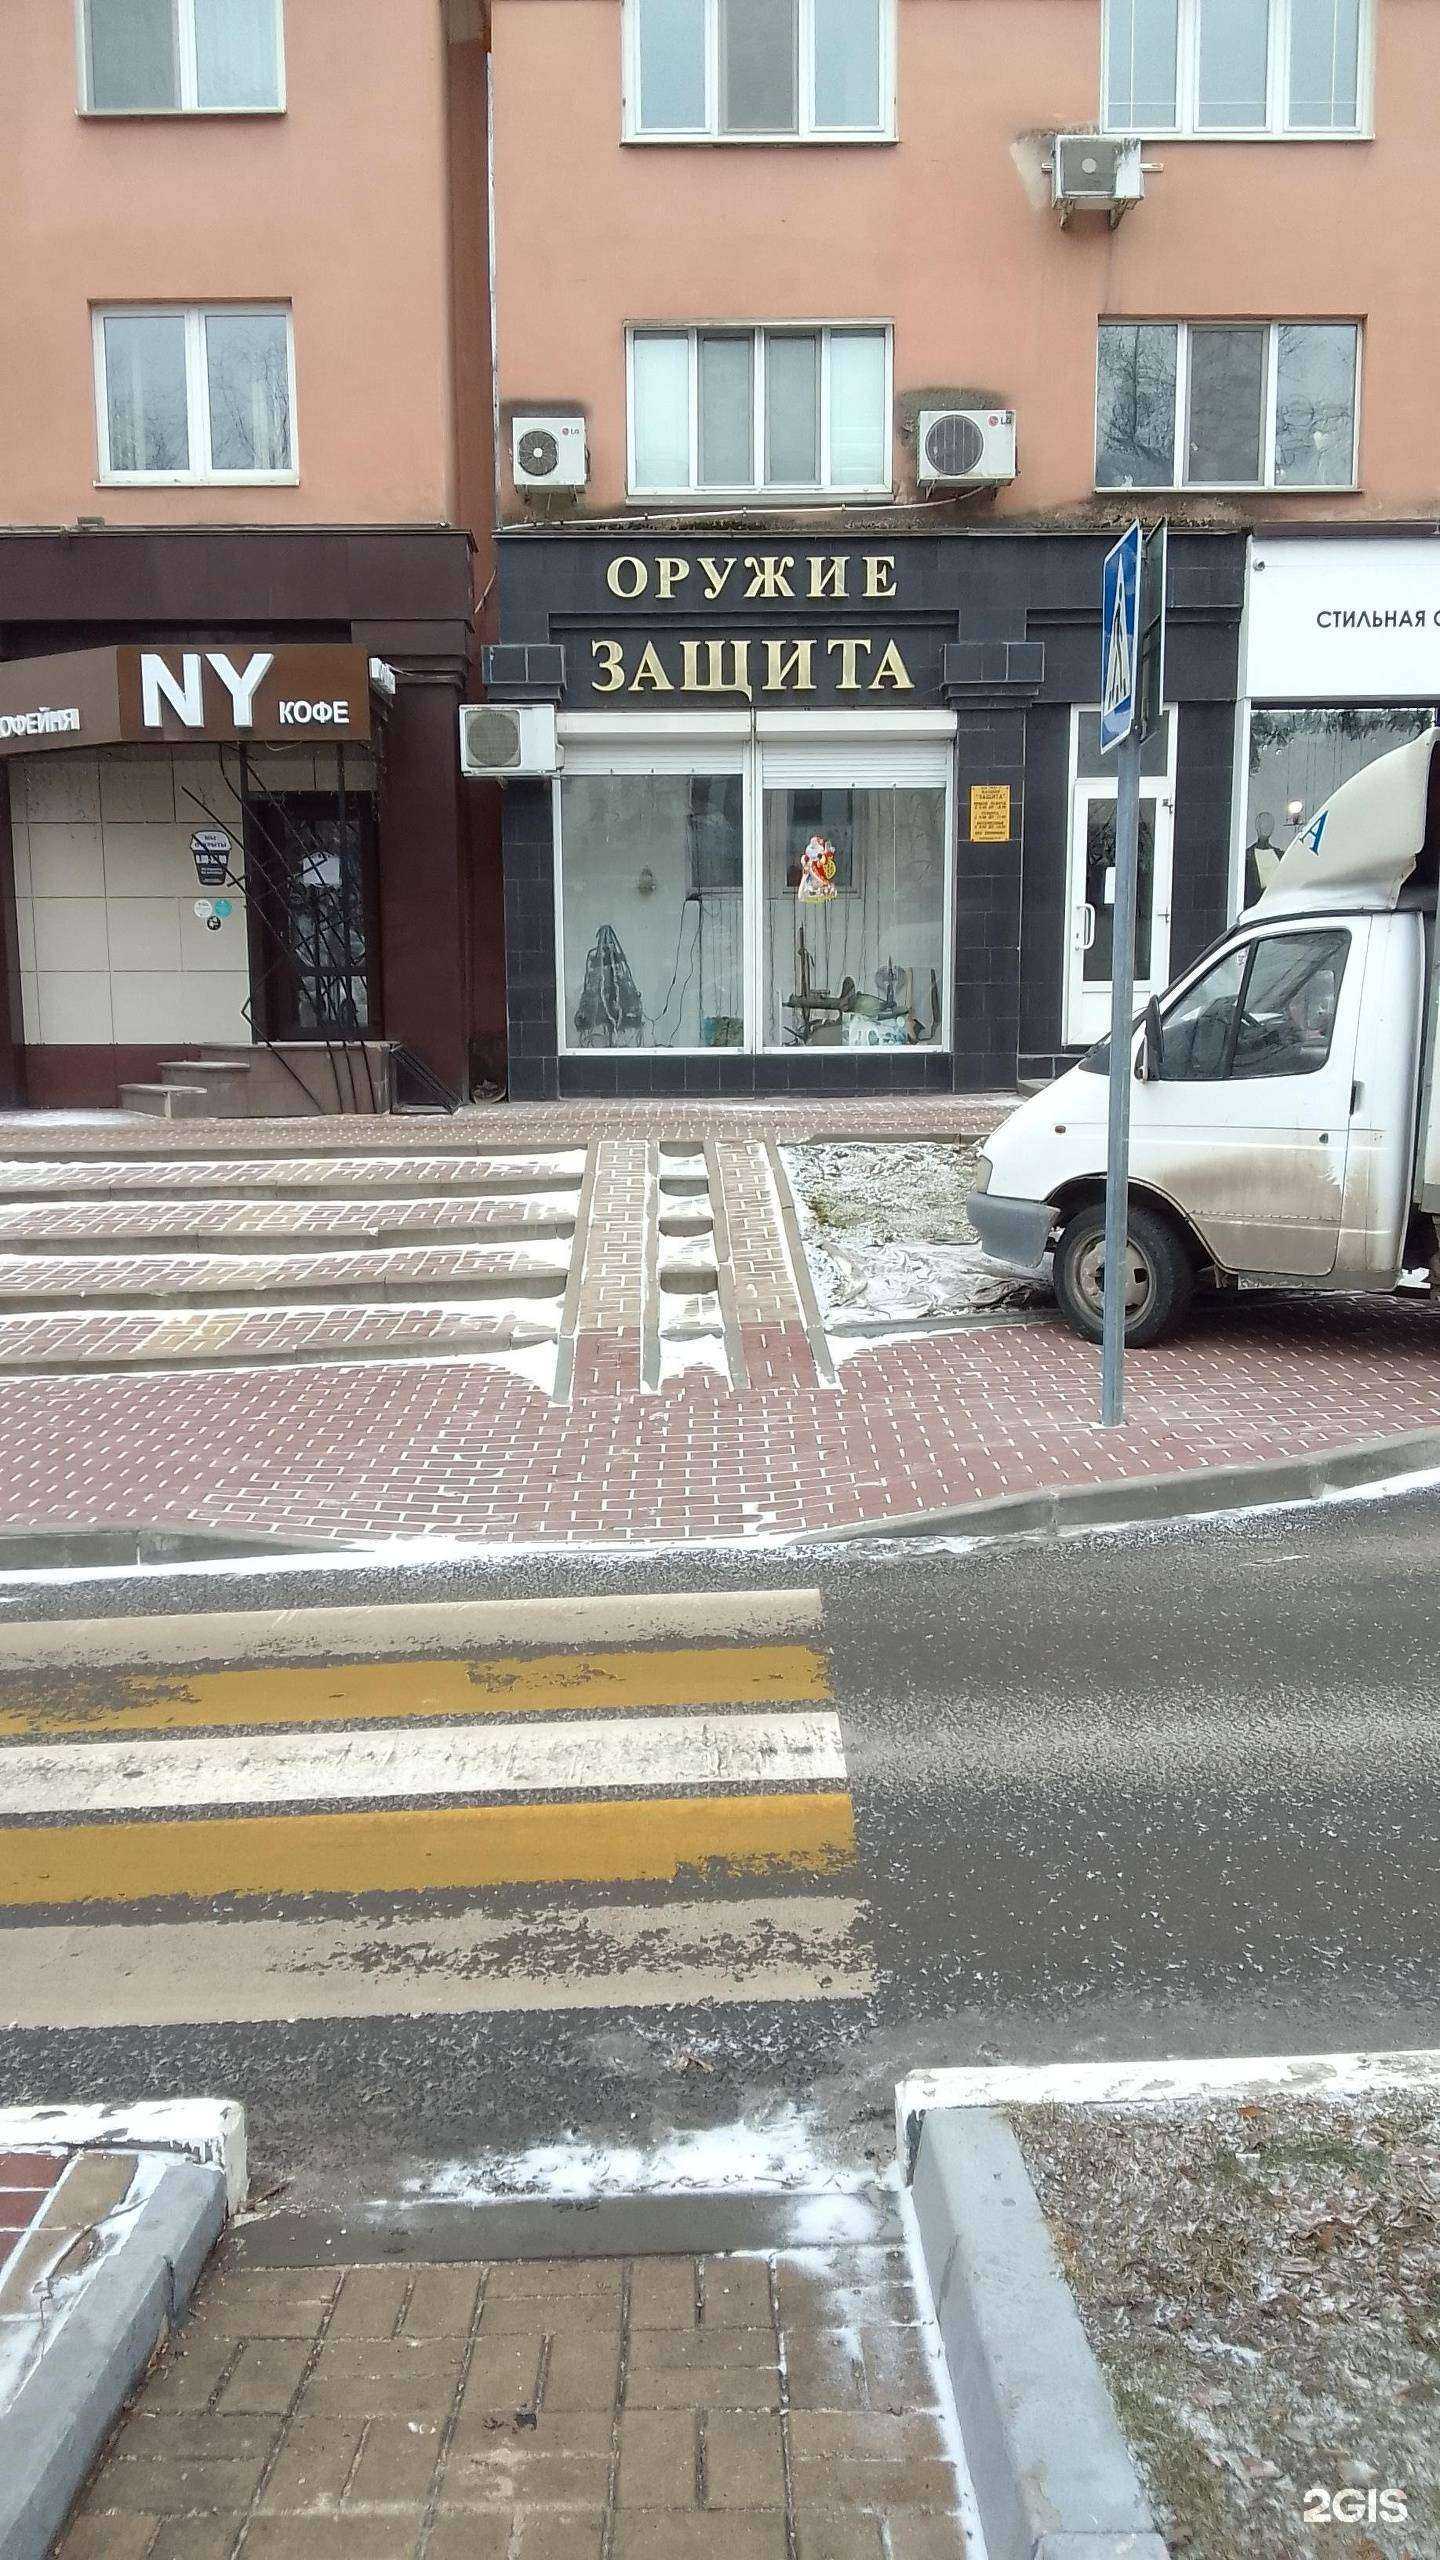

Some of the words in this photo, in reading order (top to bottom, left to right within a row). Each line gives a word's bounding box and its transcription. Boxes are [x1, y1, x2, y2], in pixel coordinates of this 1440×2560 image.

[607, 556, 898, 599] ОРУЖИЕ
[1316, 610, 1426, 628] СТИЛЬНАЯ
[140, 653, 274, 728] NY
[591, 638, 915, 702] ЗАЩИТА
[279, 700, 350, 725] КОФЕ
